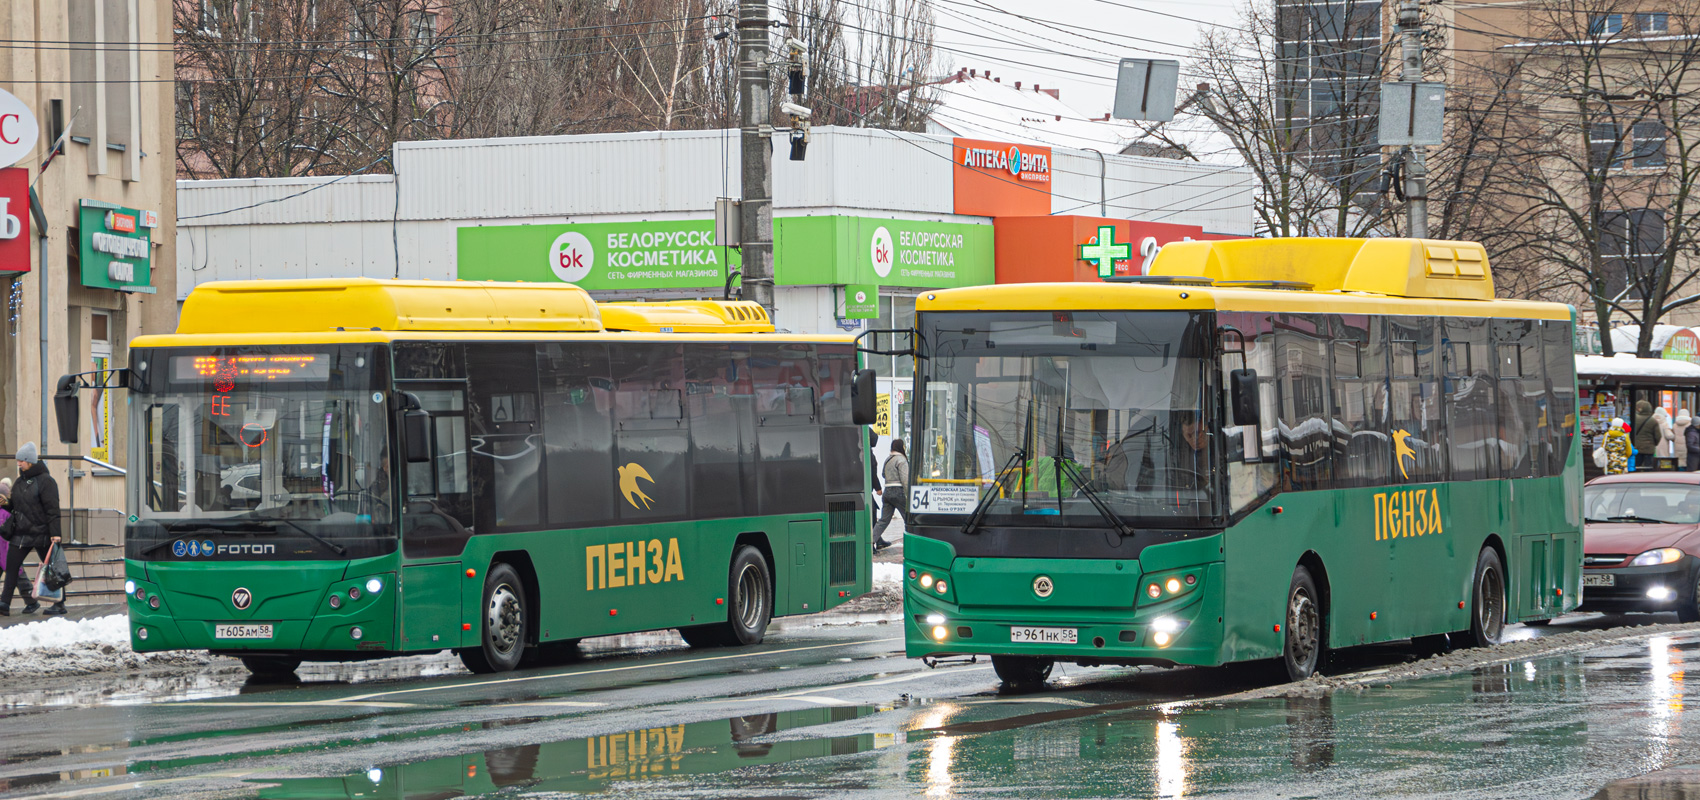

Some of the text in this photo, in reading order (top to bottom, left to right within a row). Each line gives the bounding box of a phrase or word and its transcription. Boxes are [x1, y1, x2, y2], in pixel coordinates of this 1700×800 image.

[964, 147, 1049, 173] АПТЕКА ВИТА
[1020, 172, 1050, 182] ЭКСПРЕСС
[607, 230, 716, 249] БЕЛОРУССК
[900, 231, 964, 248] БЕЛОРУССКАЯ
[607, 249, 718, 268] КОСМЕТИКА
[900, 249, 955, 267] КОСМЕТИКА
[607, 269, 718, 280] СЕТЬ ФИРМЕННЫХ МАГАЗИНОВ
[1671, 336, 1699, 355] АПТЕКА
[912, 489, 930, 510] 54
[1373, 487, 1443, 541] ПЕНЗА
[217, 544, 275, 554] FOTON
[586, 537, 685, 591] ПЕНЗА
